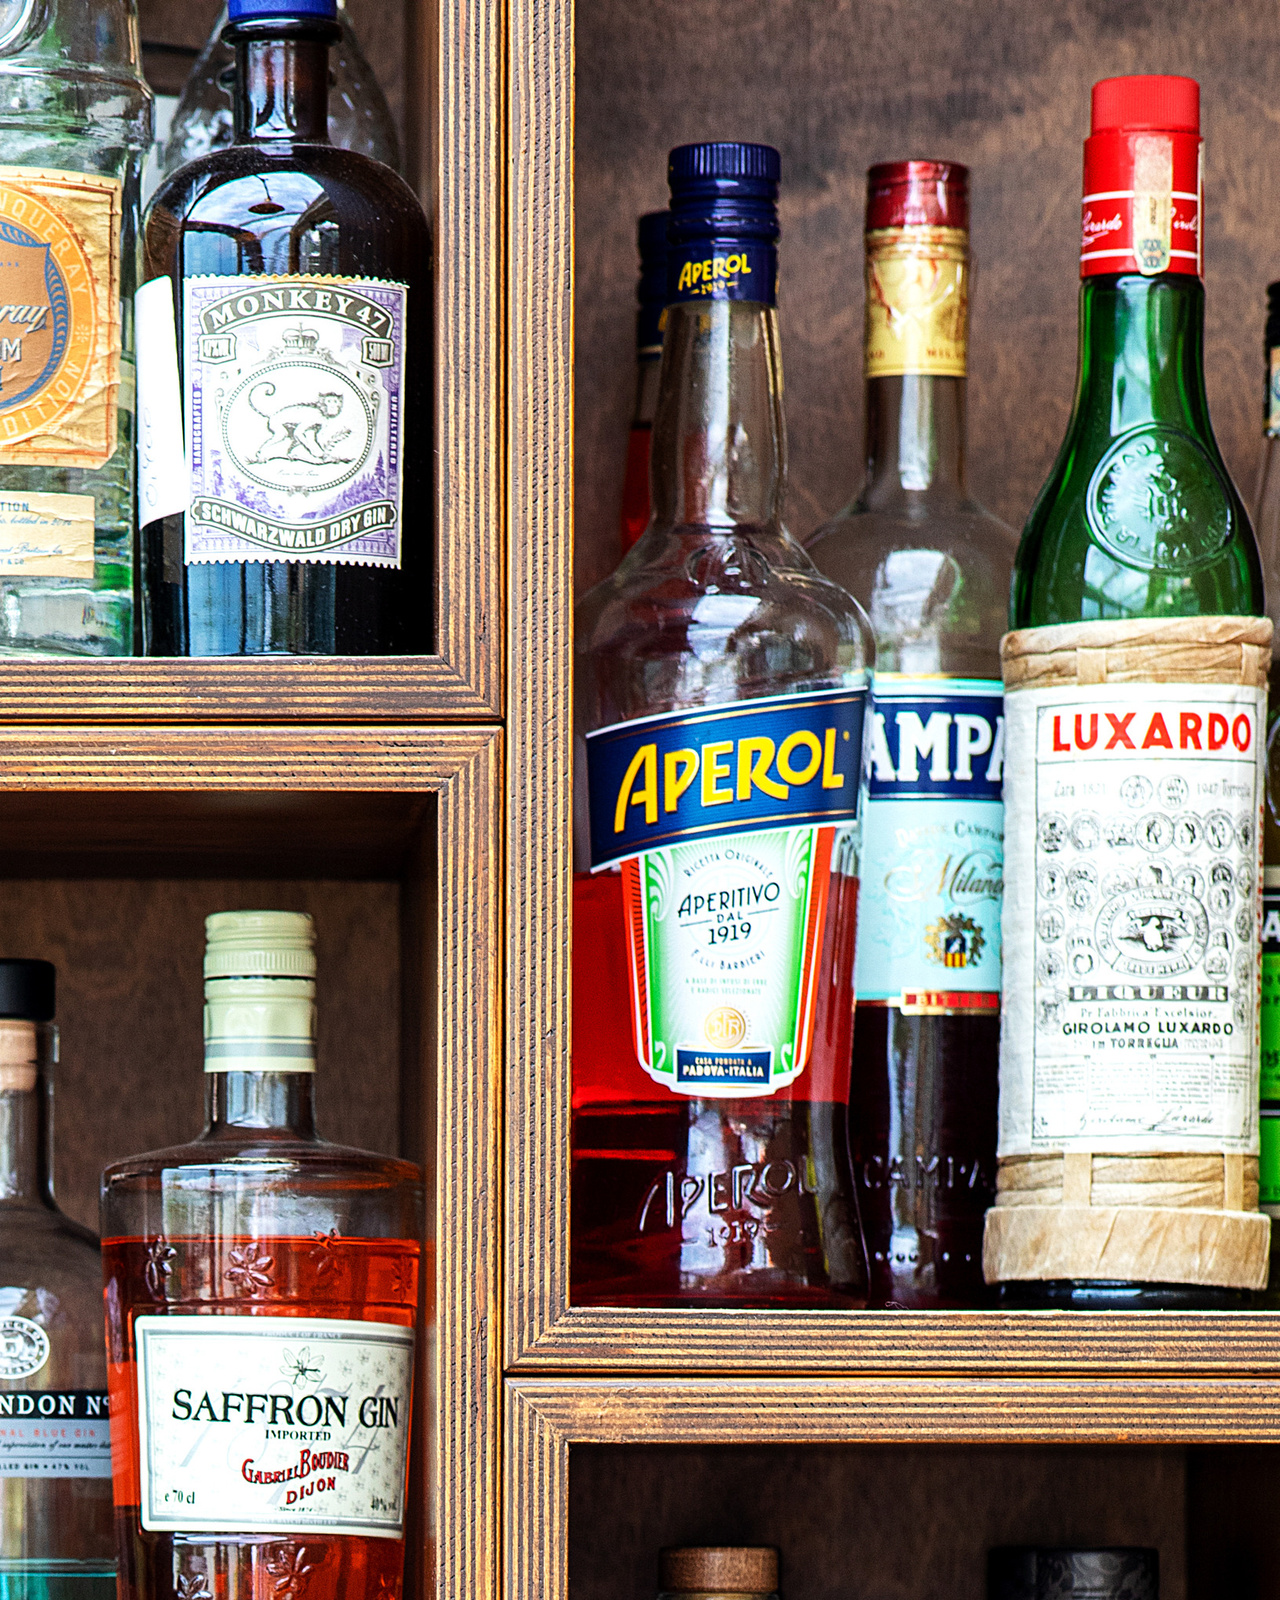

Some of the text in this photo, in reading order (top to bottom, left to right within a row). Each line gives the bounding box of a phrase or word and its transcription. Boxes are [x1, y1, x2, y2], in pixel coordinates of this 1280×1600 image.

[677, 254, 752, 291] APEROL
[209, 289, 388, 331] MONKEY 47
[201, 503, 387, 548] SCHWARZWALD DRY GIN
[1052, 711, 1252, 753] LUXARDO
[613, 726, 845, 834] APEROL
[678, 880, 781, 919] APERITIVO
[716, 910, 744, 924] DAL
[707, 922, 752, 946] 1919
[1069, 985, 1229, 1002] LIQUEUR
[1062, 1019, 1235, 1038] GIROLAMO LUXARDO
[172, 1388, 400, 1430] SAFFRON GIN
[265, 1429, 332, 1441] IMPORTED
[299, 1447, 350, 1480] BOUDIER
[286, 1476, 336, 1505] DIJON
